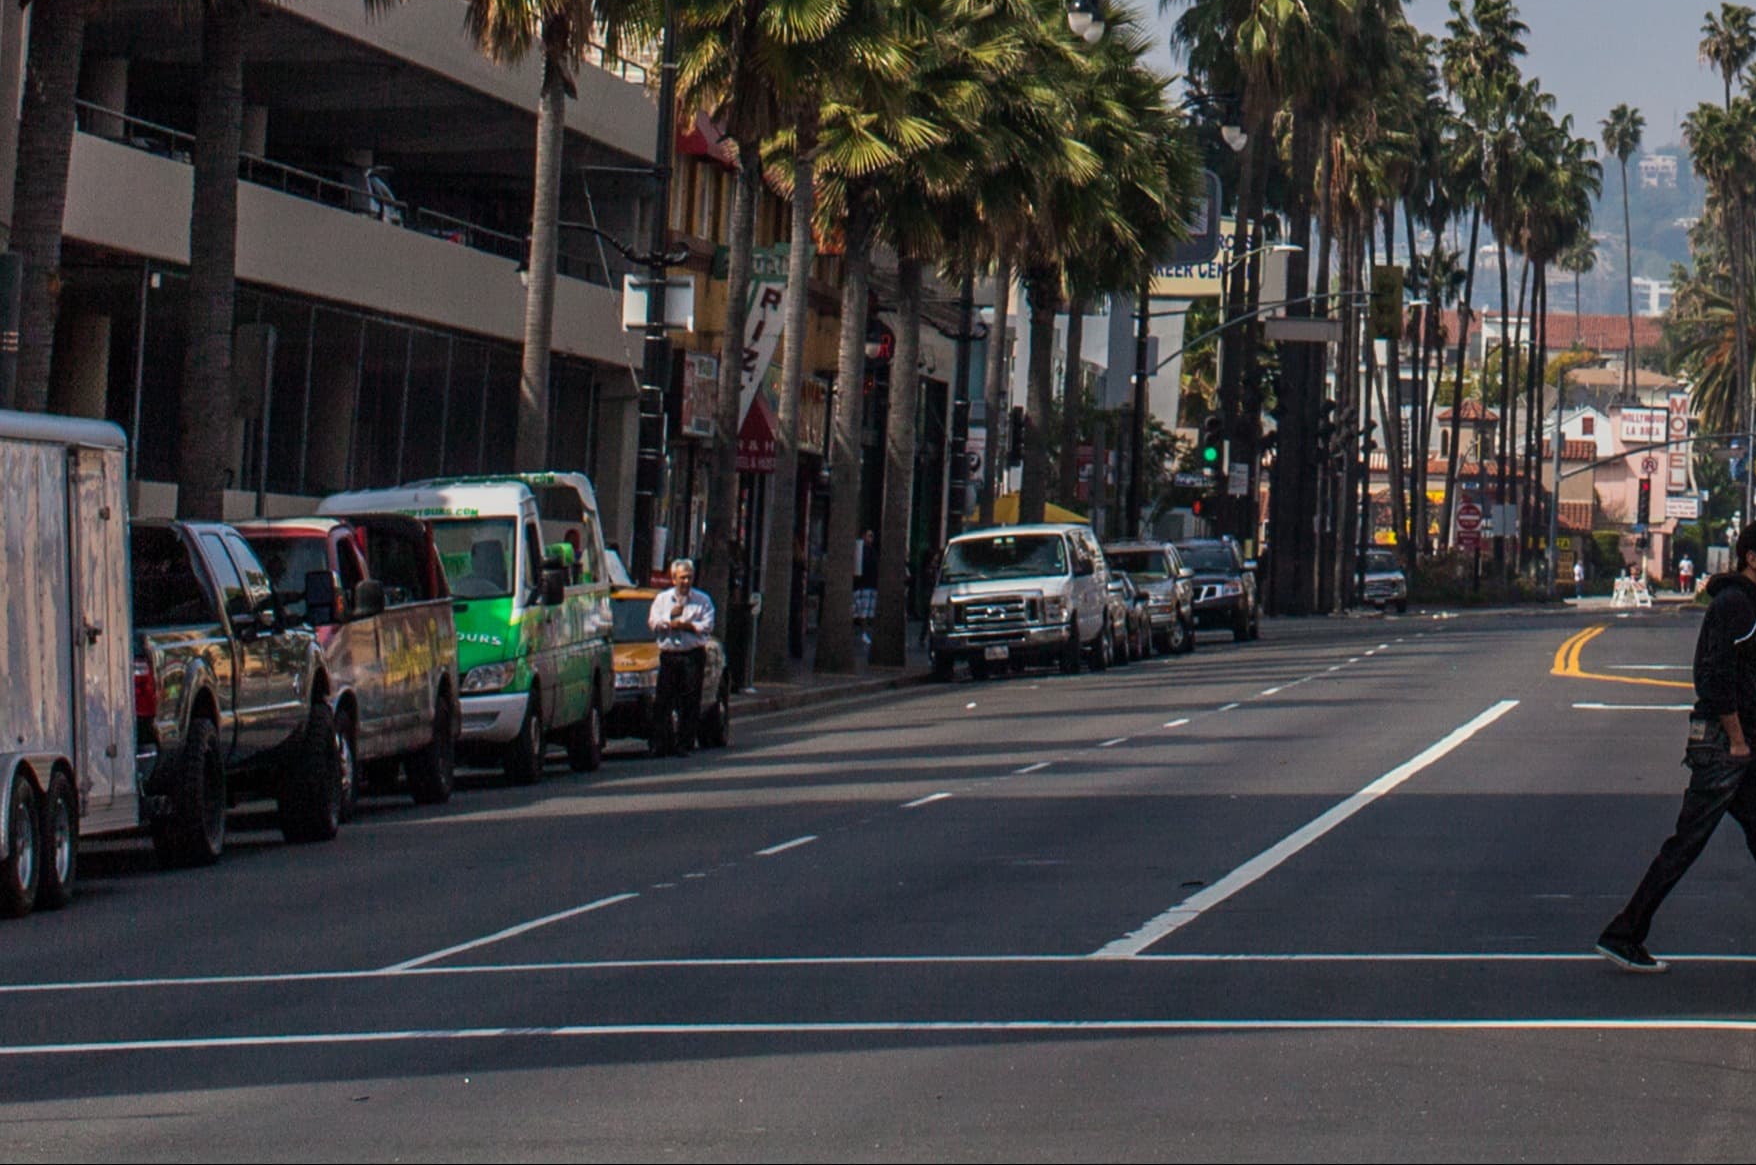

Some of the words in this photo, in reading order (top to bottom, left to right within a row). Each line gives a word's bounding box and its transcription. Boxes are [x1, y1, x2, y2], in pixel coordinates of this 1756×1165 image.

[1622, 413, 1667, 423] HOLLYWOOD
[1626, 426, 1636, 435] LA
[1669, 398, 1688, 487] MOTEL
[457, 632, 502, 646] OURS
